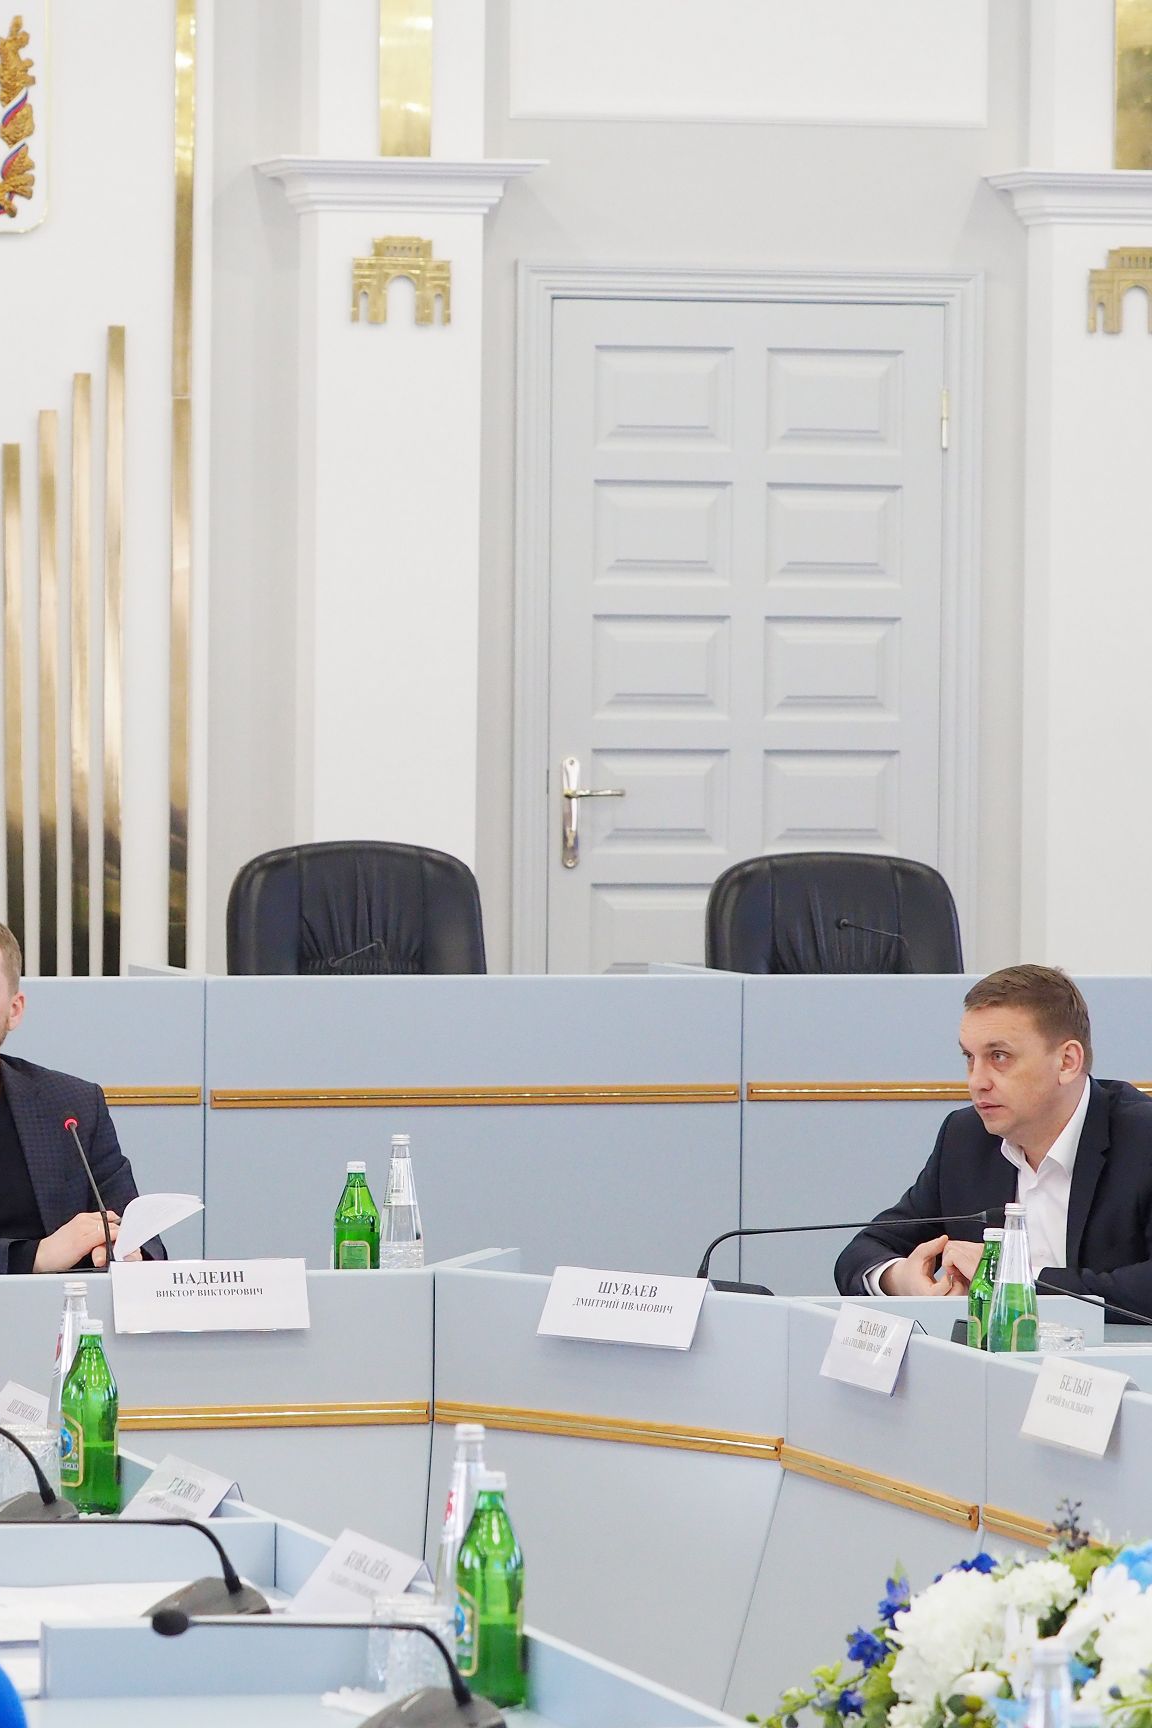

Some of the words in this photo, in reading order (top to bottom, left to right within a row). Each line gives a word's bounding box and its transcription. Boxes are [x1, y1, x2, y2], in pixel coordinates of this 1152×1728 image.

[172, 1271, 245, 1285] НАДЕИН
[156, 1289, 195, 1298] ВИКТОР
[197, 1287, 264, 1297] ВИКТОРОВИЧ
[598, 1281, 658, 1298] ШУВАЕВ
[572, 1297, 620, 1309] ДМИТРИЙ
[621, 1301, 673, 1314] ИВАНОВИЧ
[857, 1320, 888, 1338] ЖДАНОВ
